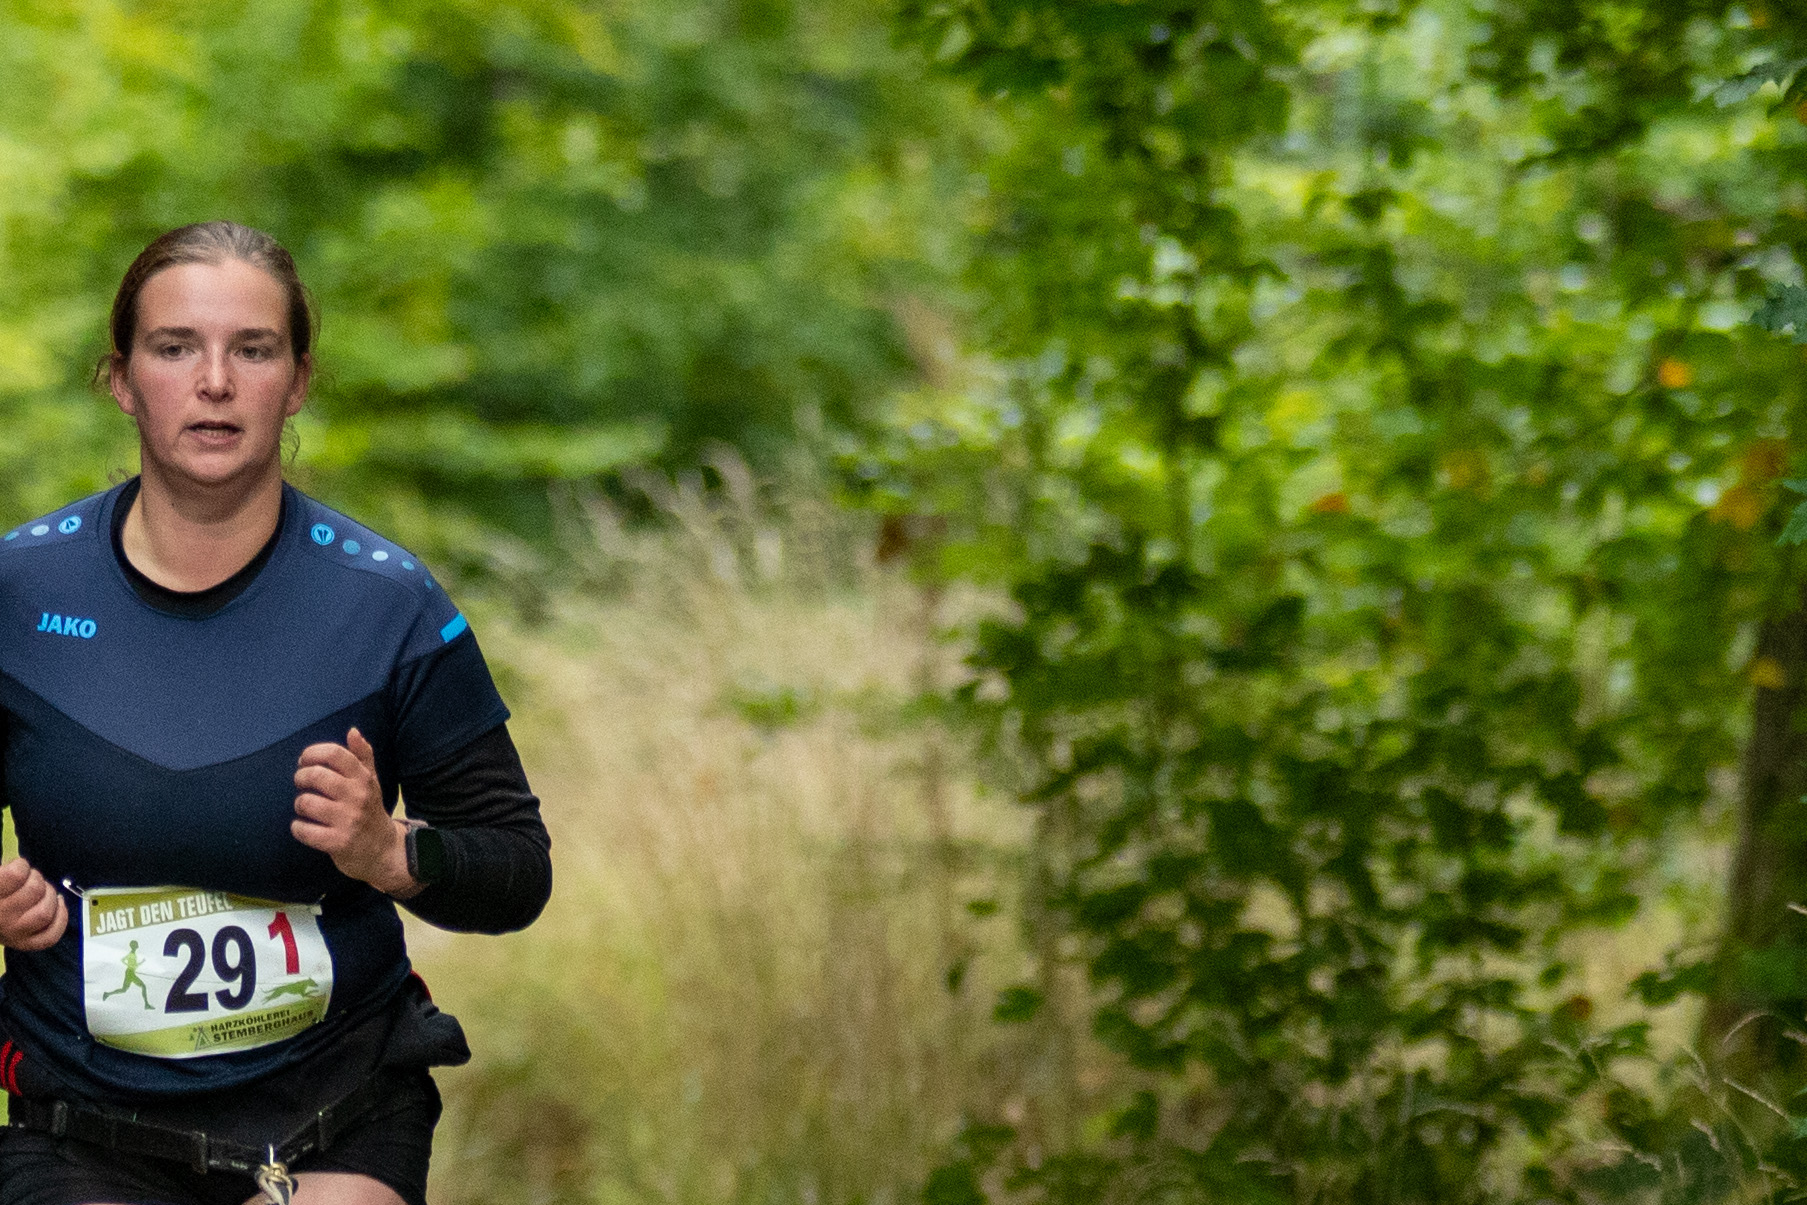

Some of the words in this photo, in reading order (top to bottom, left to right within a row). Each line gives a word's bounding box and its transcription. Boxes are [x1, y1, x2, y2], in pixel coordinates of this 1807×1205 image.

[36, 612, 97, 639] JAKO
[96, 907, 135, 934] JAGT
[140, 900, 174, 925] DEN
[163, 925, 256, 1013] 29
[267, 911, 300, 975] 1
[210, 1009, 290, 1032] HARZKÖHLEREI
